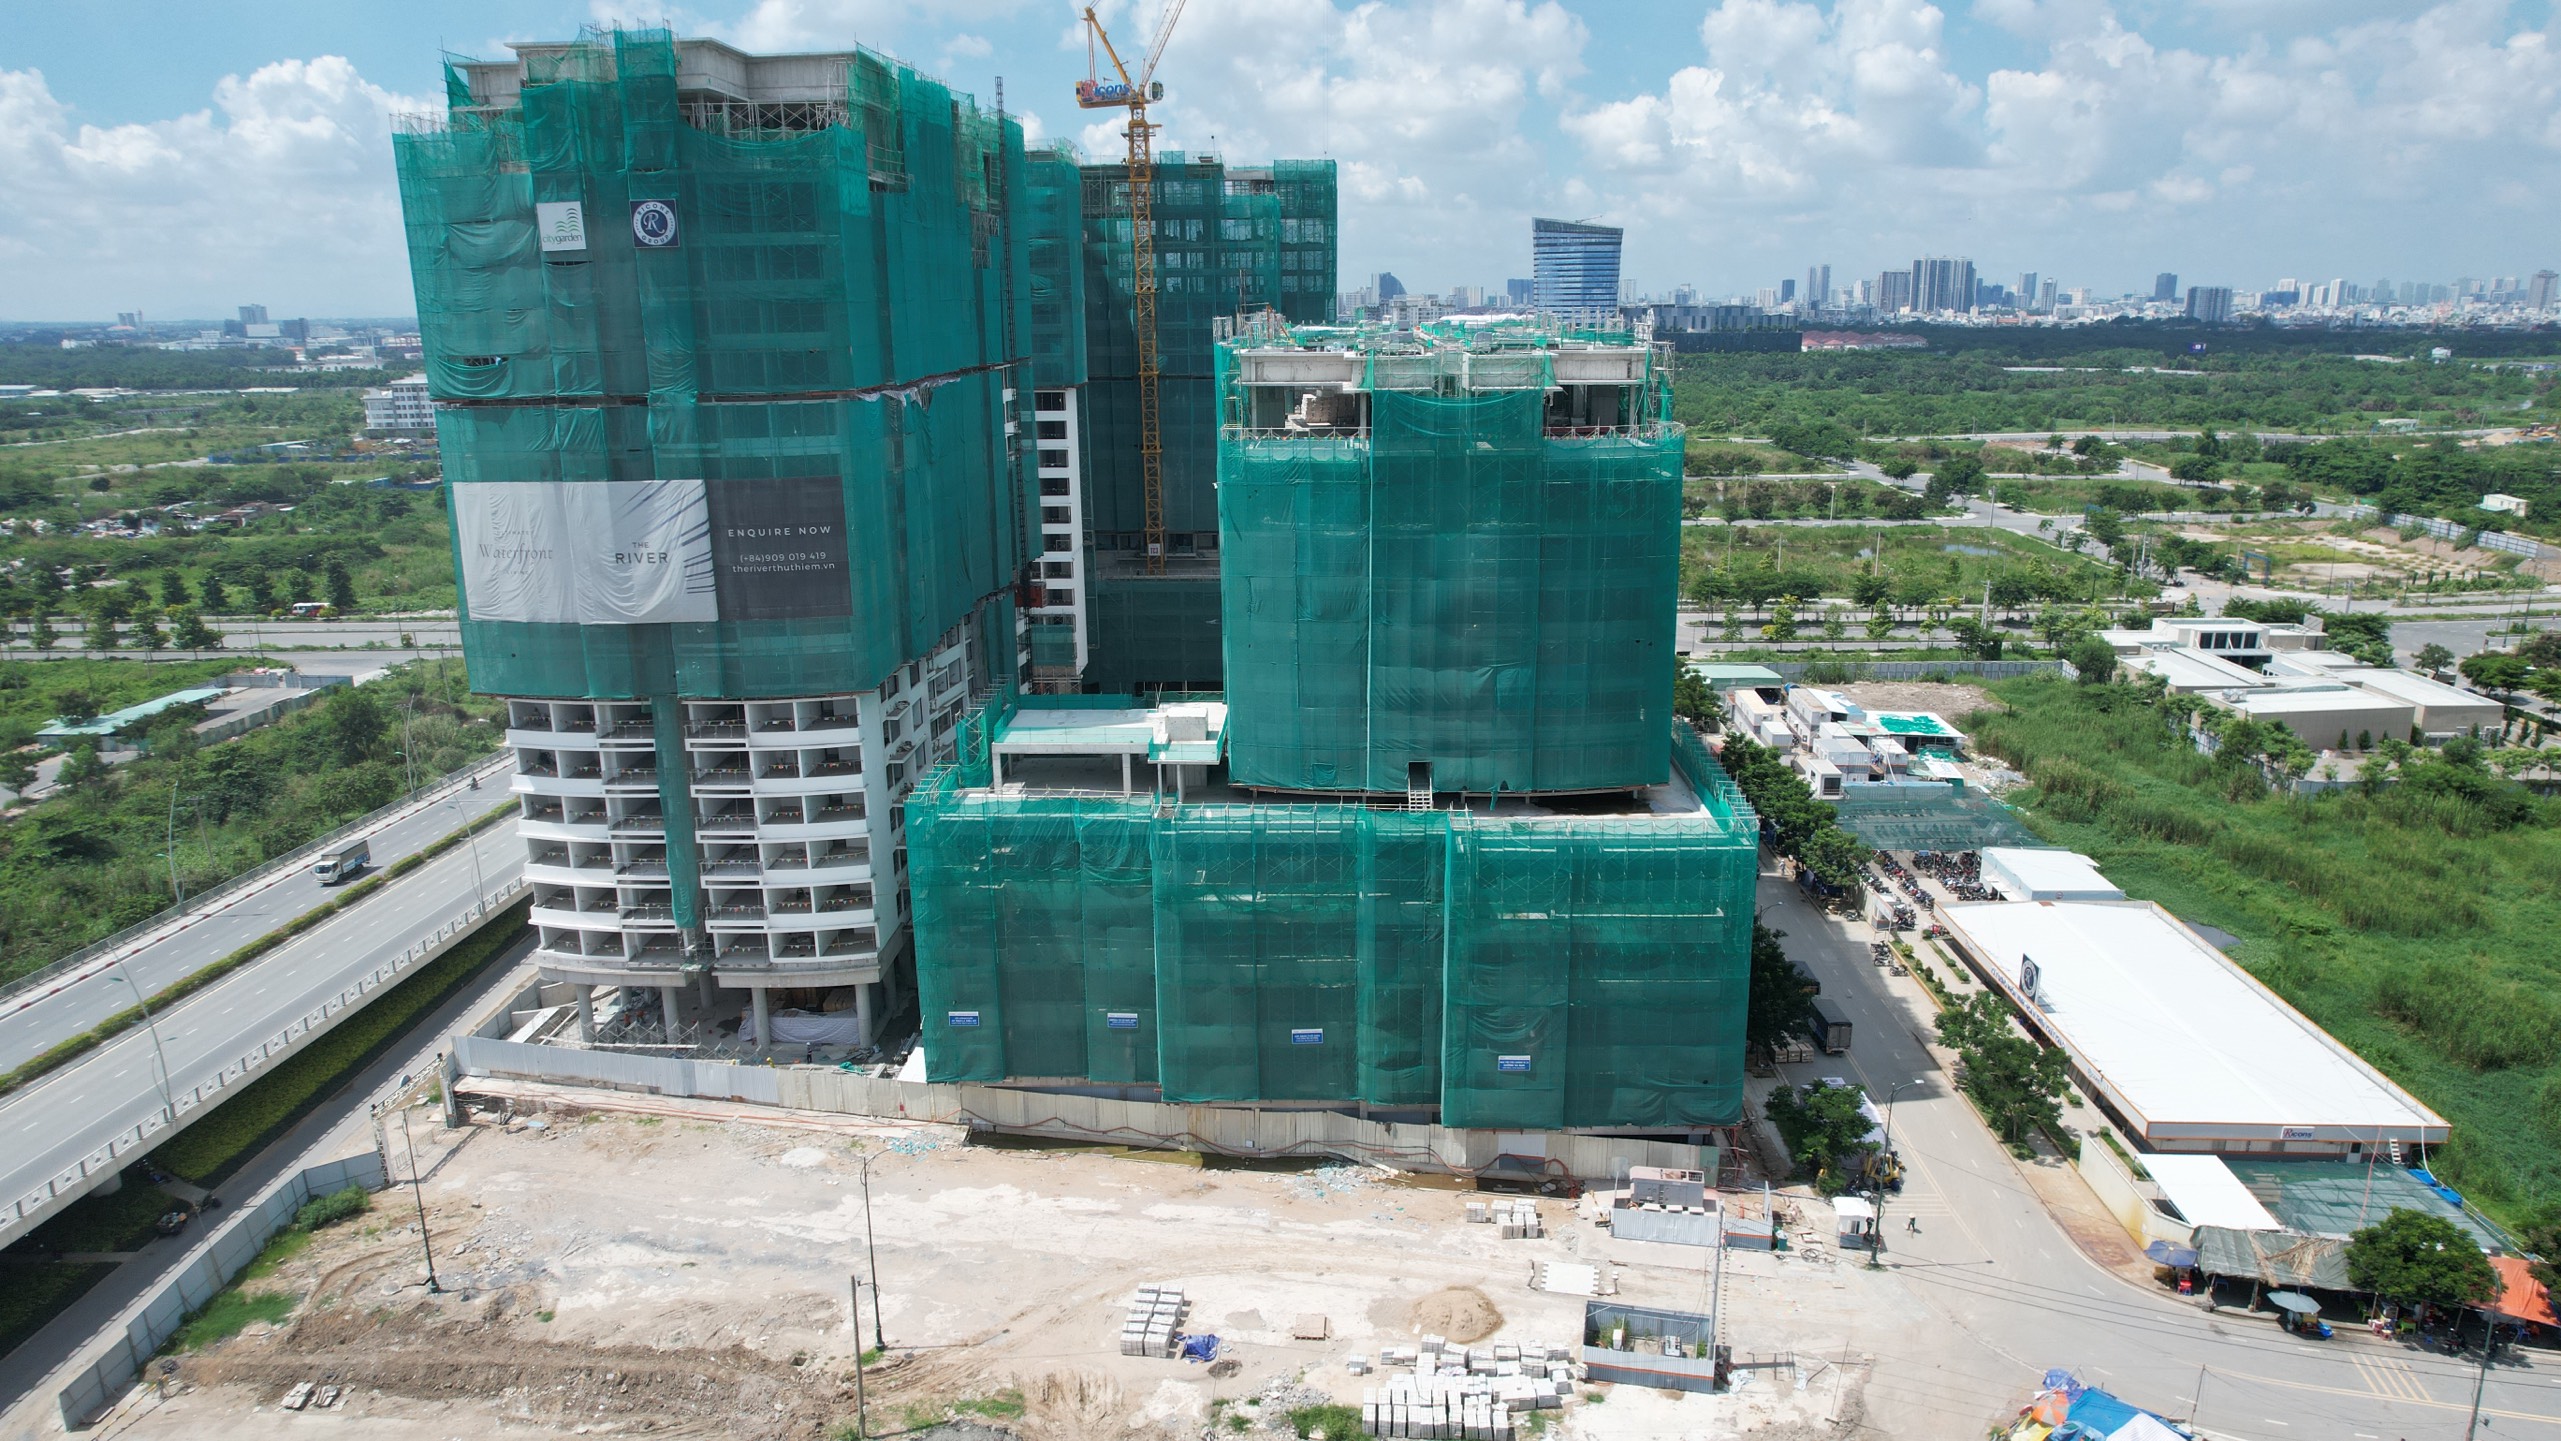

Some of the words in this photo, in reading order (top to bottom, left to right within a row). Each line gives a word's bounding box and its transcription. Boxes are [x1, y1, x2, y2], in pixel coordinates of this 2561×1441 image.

[637, 203, 670, 216] RICONS
[542, 233, 582, 244] citygarden
[641, 234, 669, 245] GROUP
[728, 527, 791, 538] ENQUIRE
[798, 525, 831, 535] NOW
[479, 542, 553, 565] Waterfront
[615, 551, 668, 564] RIVER
[740, 553, 785, 563] (+84)909
[789, 552, 806, 561] 019
[810, 551, 826, 560] 419
[732, 562, 835, 573] theriverthuthiem.vn
[2283, 1129, 2313, 1139] Ricons
